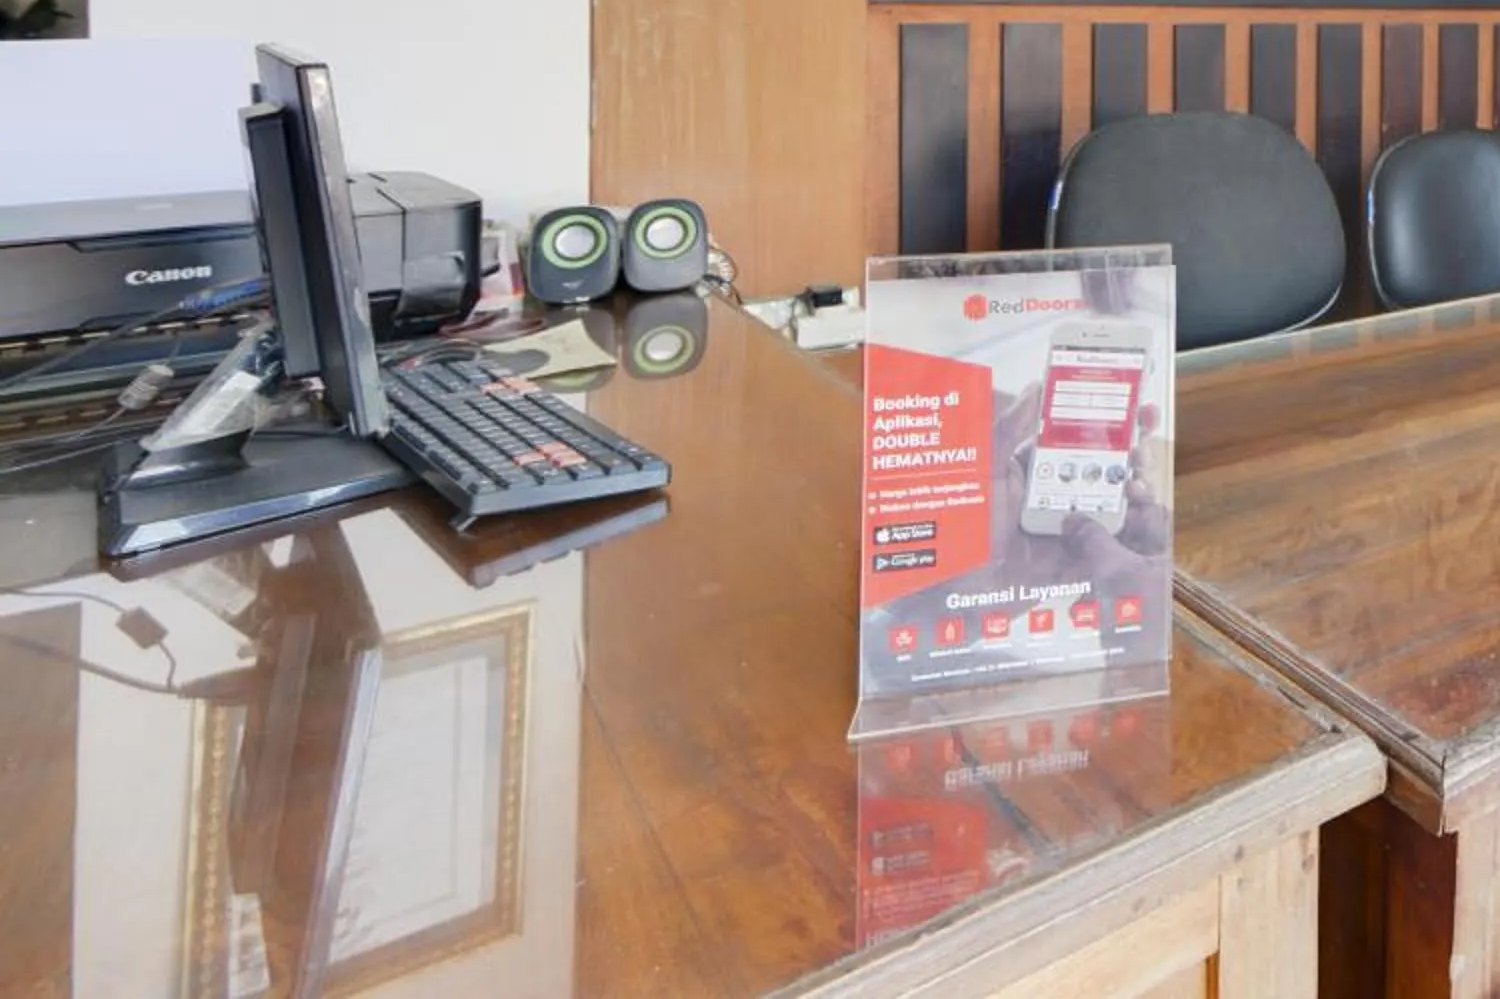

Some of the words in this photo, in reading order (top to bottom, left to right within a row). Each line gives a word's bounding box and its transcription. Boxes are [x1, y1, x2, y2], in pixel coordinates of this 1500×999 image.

[124, 265, 213, 286] Canon
[873, 394, 941, 412] Booking
[944, 391, 960, 407] di
[873, 412, 943, 432] Aplikasi,
[873, 432, 941, 450] DOUBLE
[873, 447, 977, 470] HEMATNYA!!
[945, 585, 1015, 610] Garansi
[1019, 581, 1092, 602] Layanan
